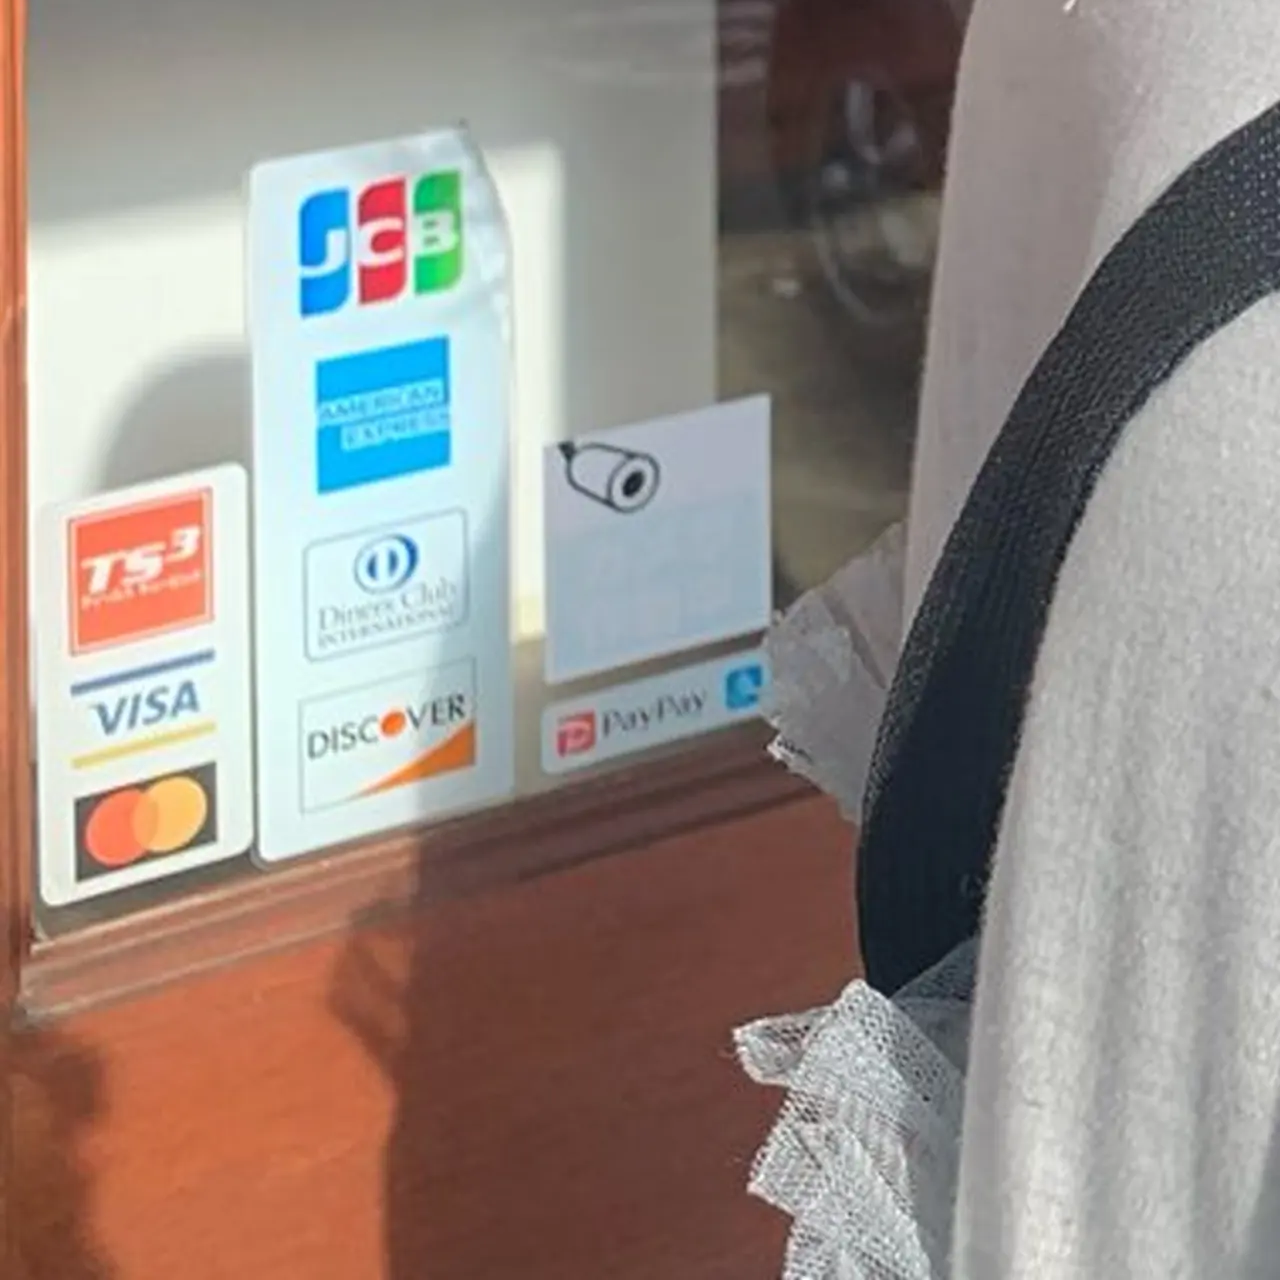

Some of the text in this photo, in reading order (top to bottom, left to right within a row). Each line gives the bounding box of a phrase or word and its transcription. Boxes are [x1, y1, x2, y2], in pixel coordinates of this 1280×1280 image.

[298, 206, 460, 282] JCB
[319, 384, 441, 420] AMERICAN
[318, 576, 458, 631] Diners Club
[91, 679, 200, 736] VISA
[306, 693, 466, 760] DISCOVER
[602, 689, 708, 738] PayPay
